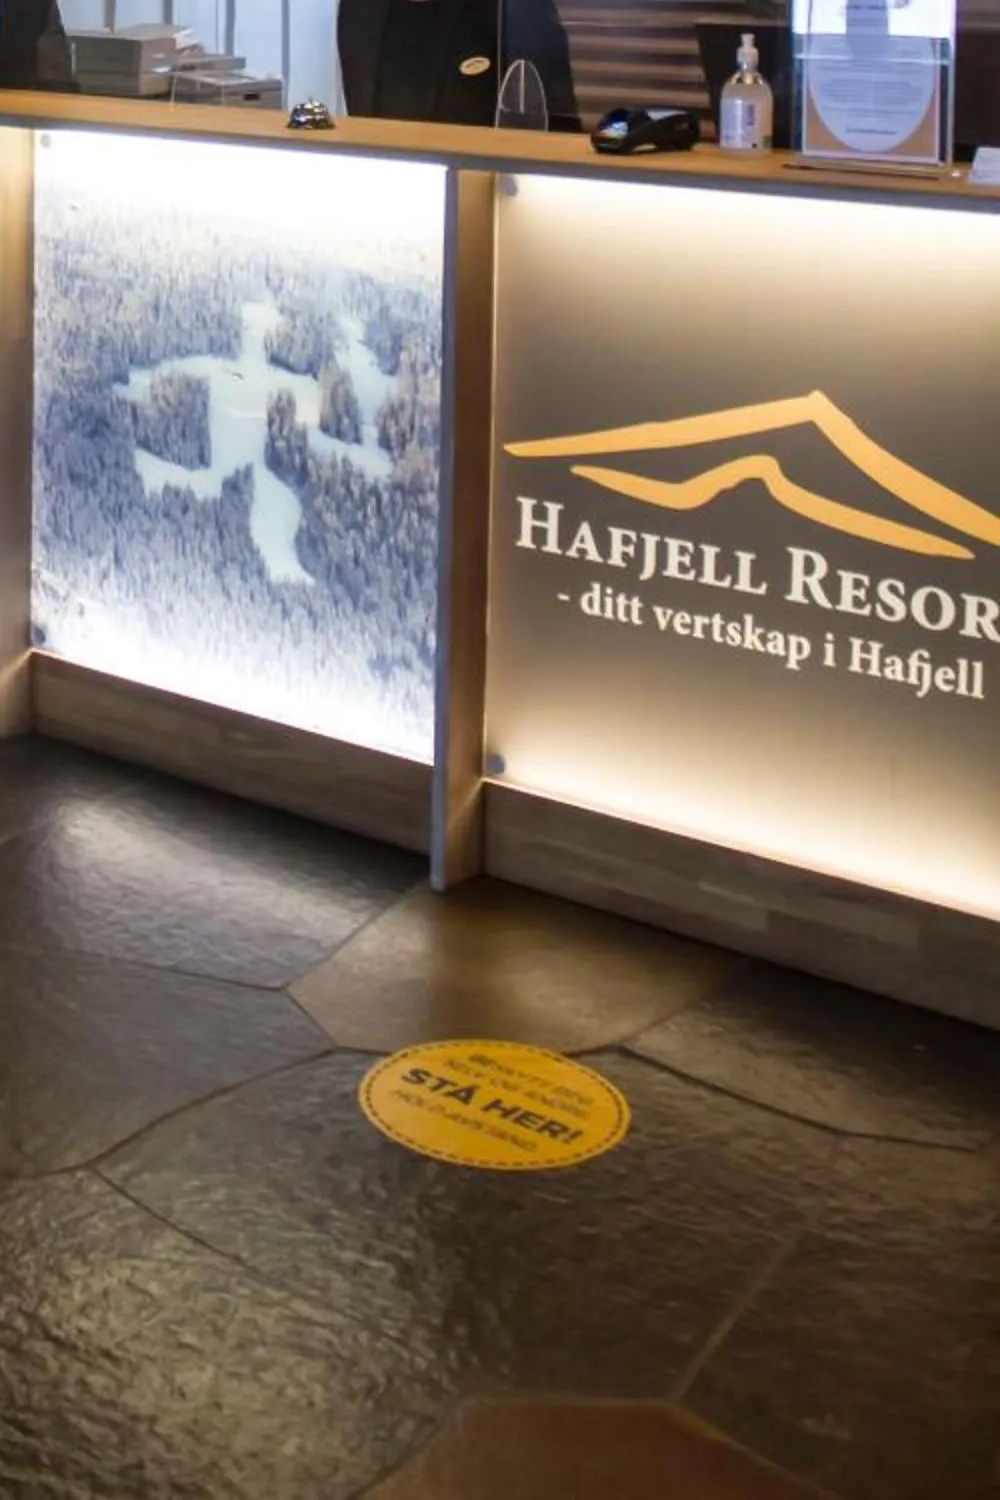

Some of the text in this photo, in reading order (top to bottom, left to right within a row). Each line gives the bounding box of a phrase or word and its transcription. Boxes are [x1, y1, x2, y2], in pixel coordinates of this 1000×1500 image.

[516, 497, 1000, 643] HAFJELL RESOR
[580, 582, 643, 626] ditt
[653, 607, 811, 670] vertskap
[823, 633, 836, 667] i
[848, 637, 985, 699] Hafjell
[402, 1066, 584, 1145] STÅ HER!
